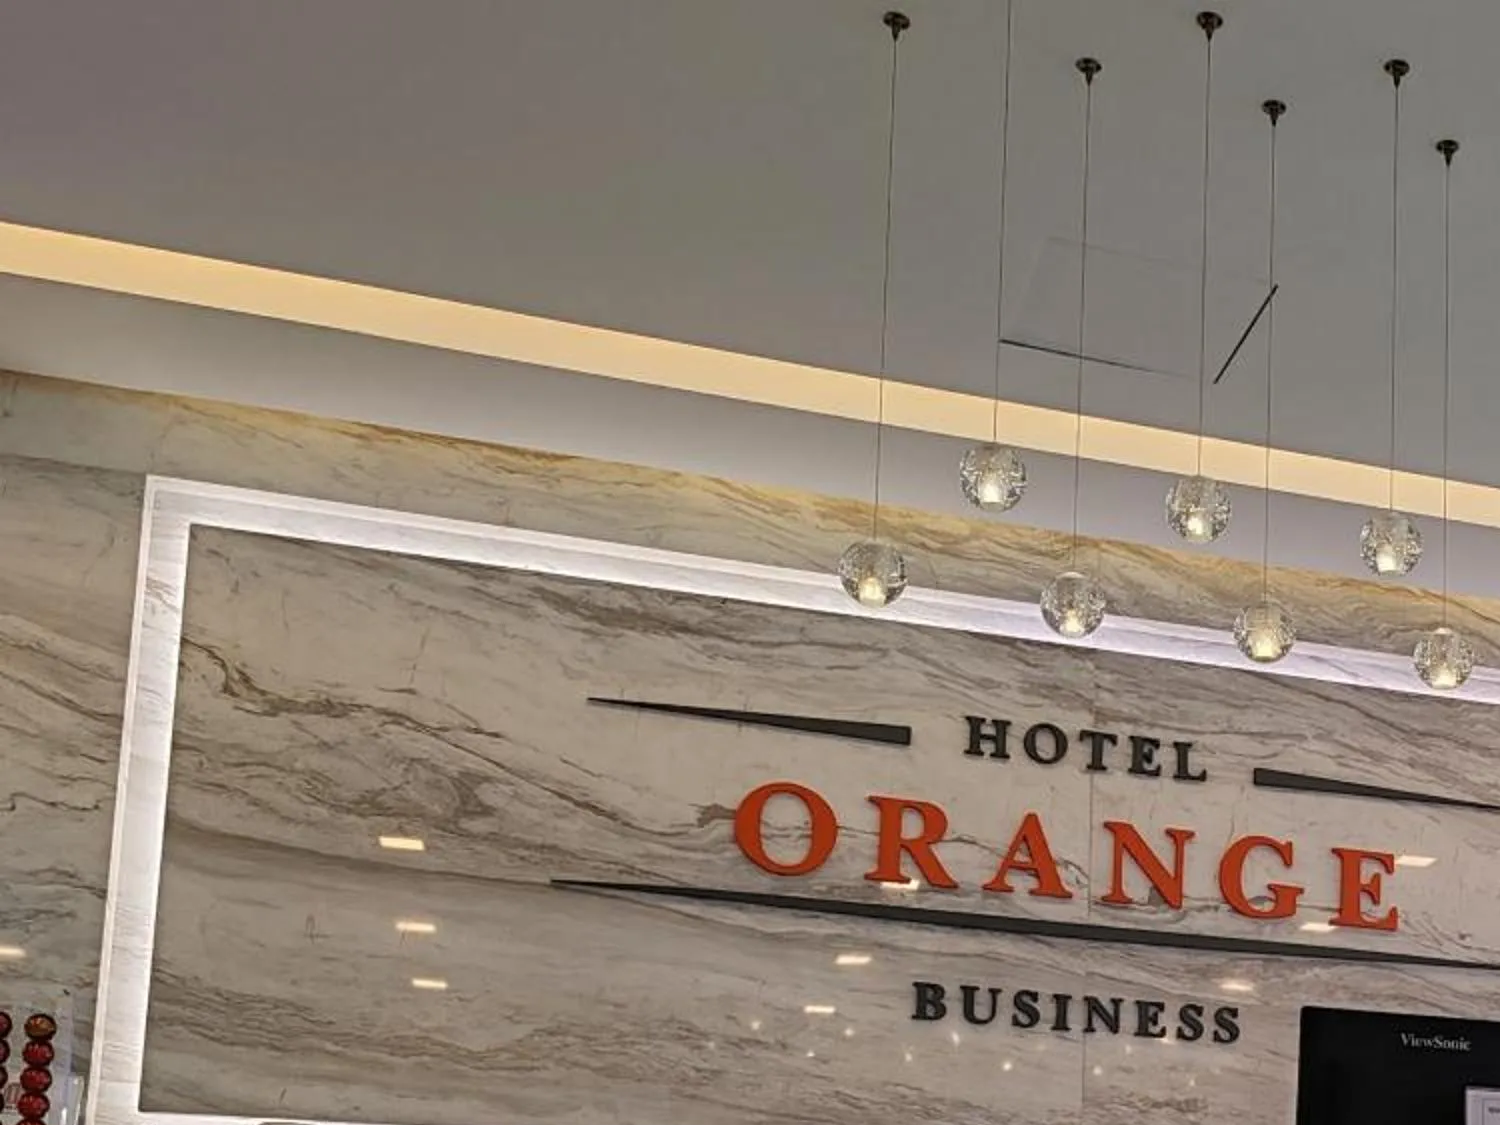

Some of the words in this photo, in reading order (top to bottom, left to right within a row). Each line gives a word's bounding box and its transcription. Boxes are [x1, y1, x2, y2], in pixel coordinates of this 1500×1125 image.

[964, 716, 1207, 783] HOTEL
[733, 780, 1401, 932] ORANGE
[911, 980, 1242, 1044] BUSINESS
[1400, 1032, 1472, 1051] ViewSonic
